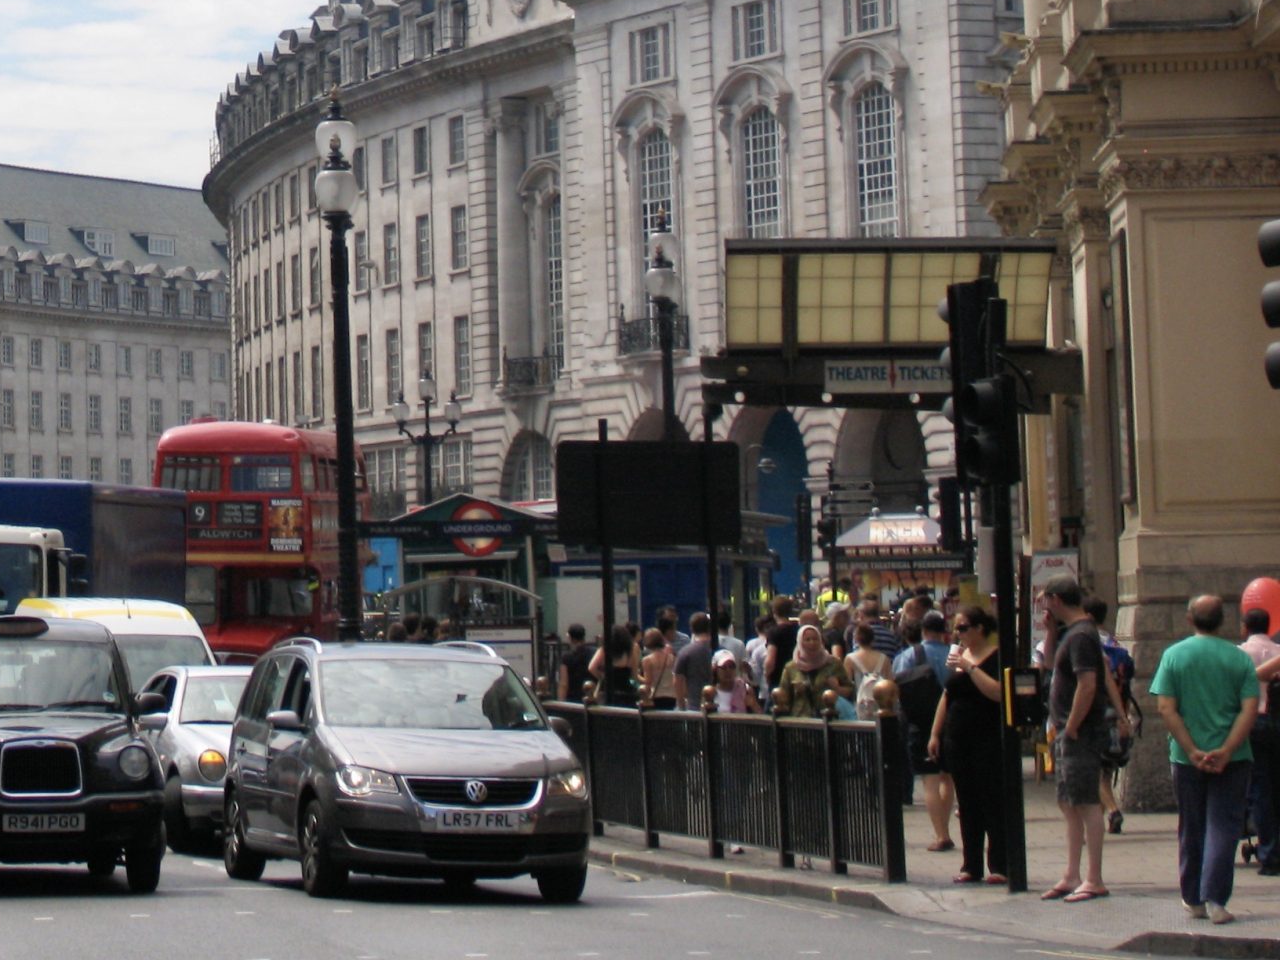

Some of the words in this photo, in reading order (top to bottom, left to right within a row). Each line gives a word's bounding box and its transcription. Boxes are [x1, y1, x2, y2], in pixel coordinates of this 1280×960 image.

[827, 366, 887, 381] THEATRE
[195, 506, 205, 521] 9
[200, 528, 252, 539] ALDWYCH
[442, 523, 512, 534] UNDERGROUND
[7, 815, 45, 830] R941
[442, 813, 481, 827] LR57
[485, 813, 514, 828] FRL
